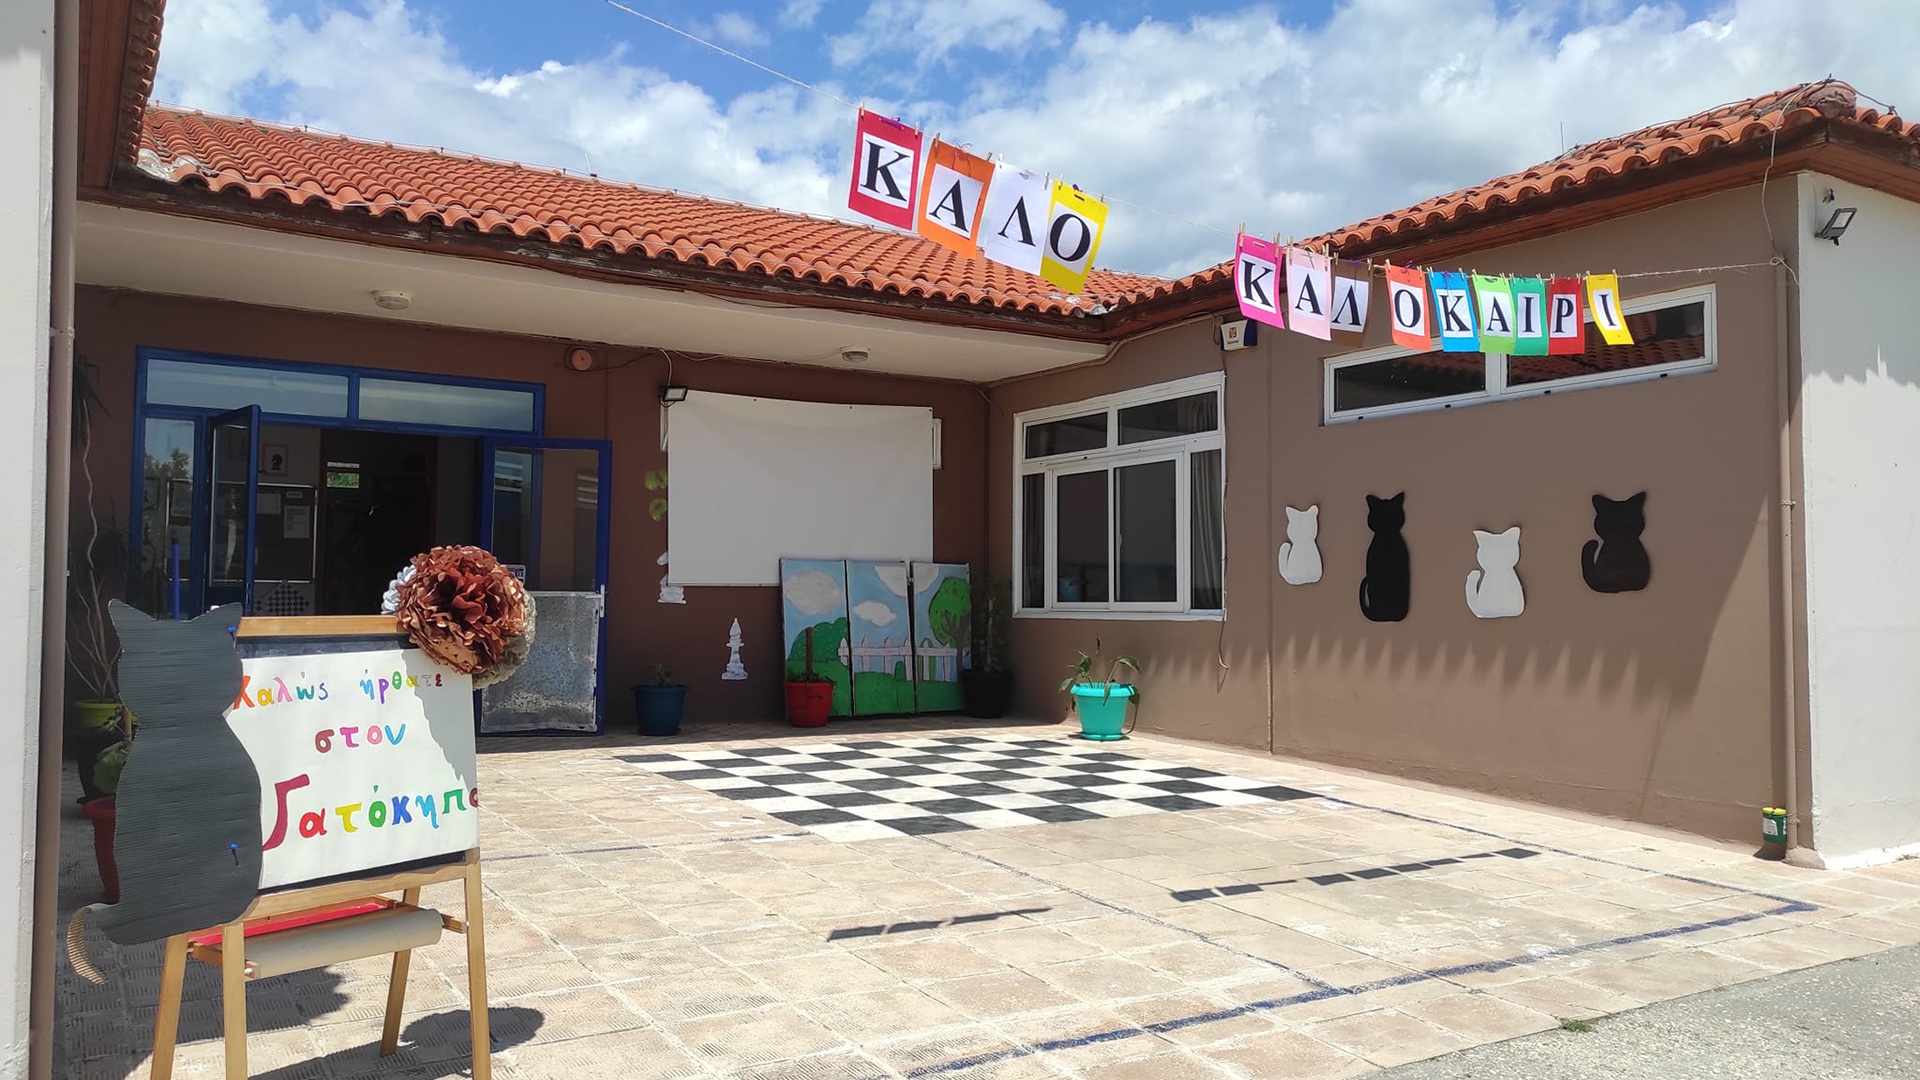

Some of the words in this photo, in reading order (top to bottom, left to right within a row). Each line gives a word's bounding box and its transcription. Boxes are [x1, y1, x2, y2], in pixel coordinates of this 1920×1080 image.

[860, 139, 1092, 263] ΚΑΛΟ
[1240, 259, 1618, 334] ΚΑΛΟΚΑΙΡΙ
[314, 723, 406, 753] στον
